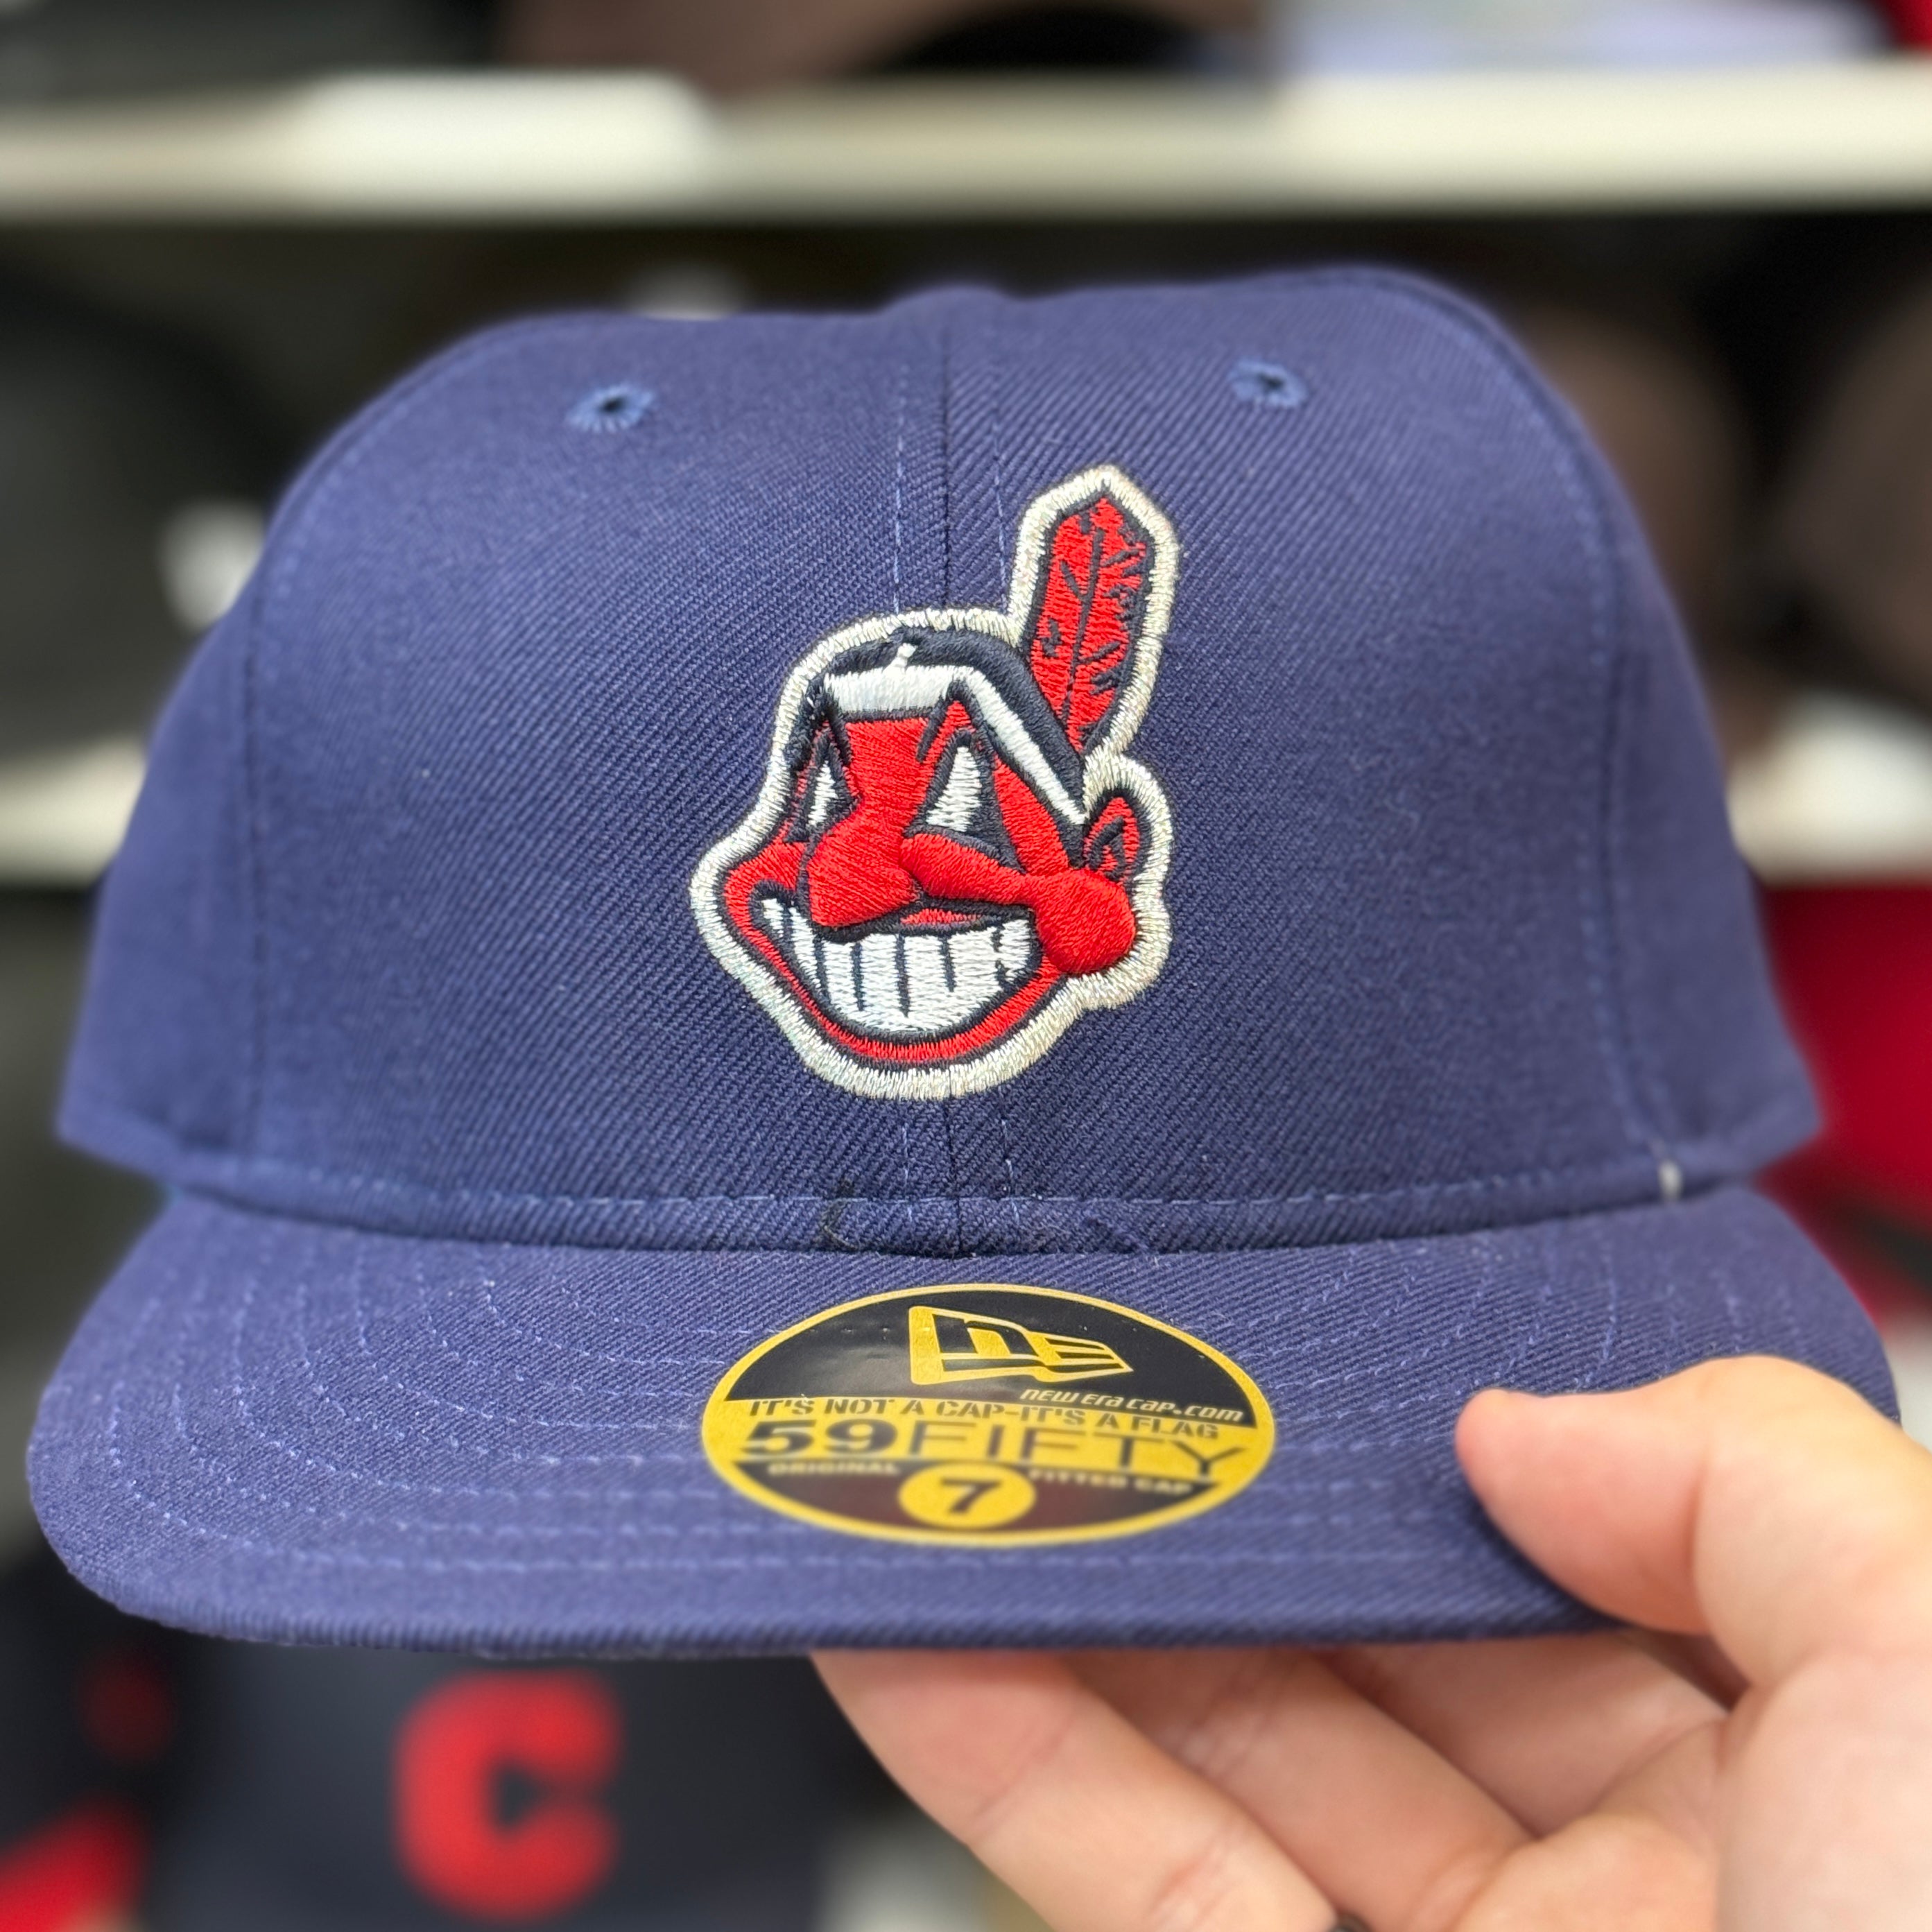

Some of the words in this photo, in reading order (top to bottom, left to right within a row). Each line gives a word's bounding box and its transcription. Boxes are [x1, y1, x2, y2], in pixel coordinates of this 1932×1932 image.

[749, 1399, 816, 1416] IT'S
[824, 1399, 895, 1415] NOT
[900, 1400, 925, 1415] A
[1095, 1412, 1120, 1429] A
[1131, 1415, 1219, 1440] FLAG
[739, 1418, 1247, 1477] 59FIFTY
[767, 1460, 902, 1477] ORIGINAL
[1028, 1467, 1129, 1490] FITTED
[1134, 1476, 1194, 1497] CAP
[939, 1477, 1003, 1515] 7
[390, 1666, 622, 1922] C
